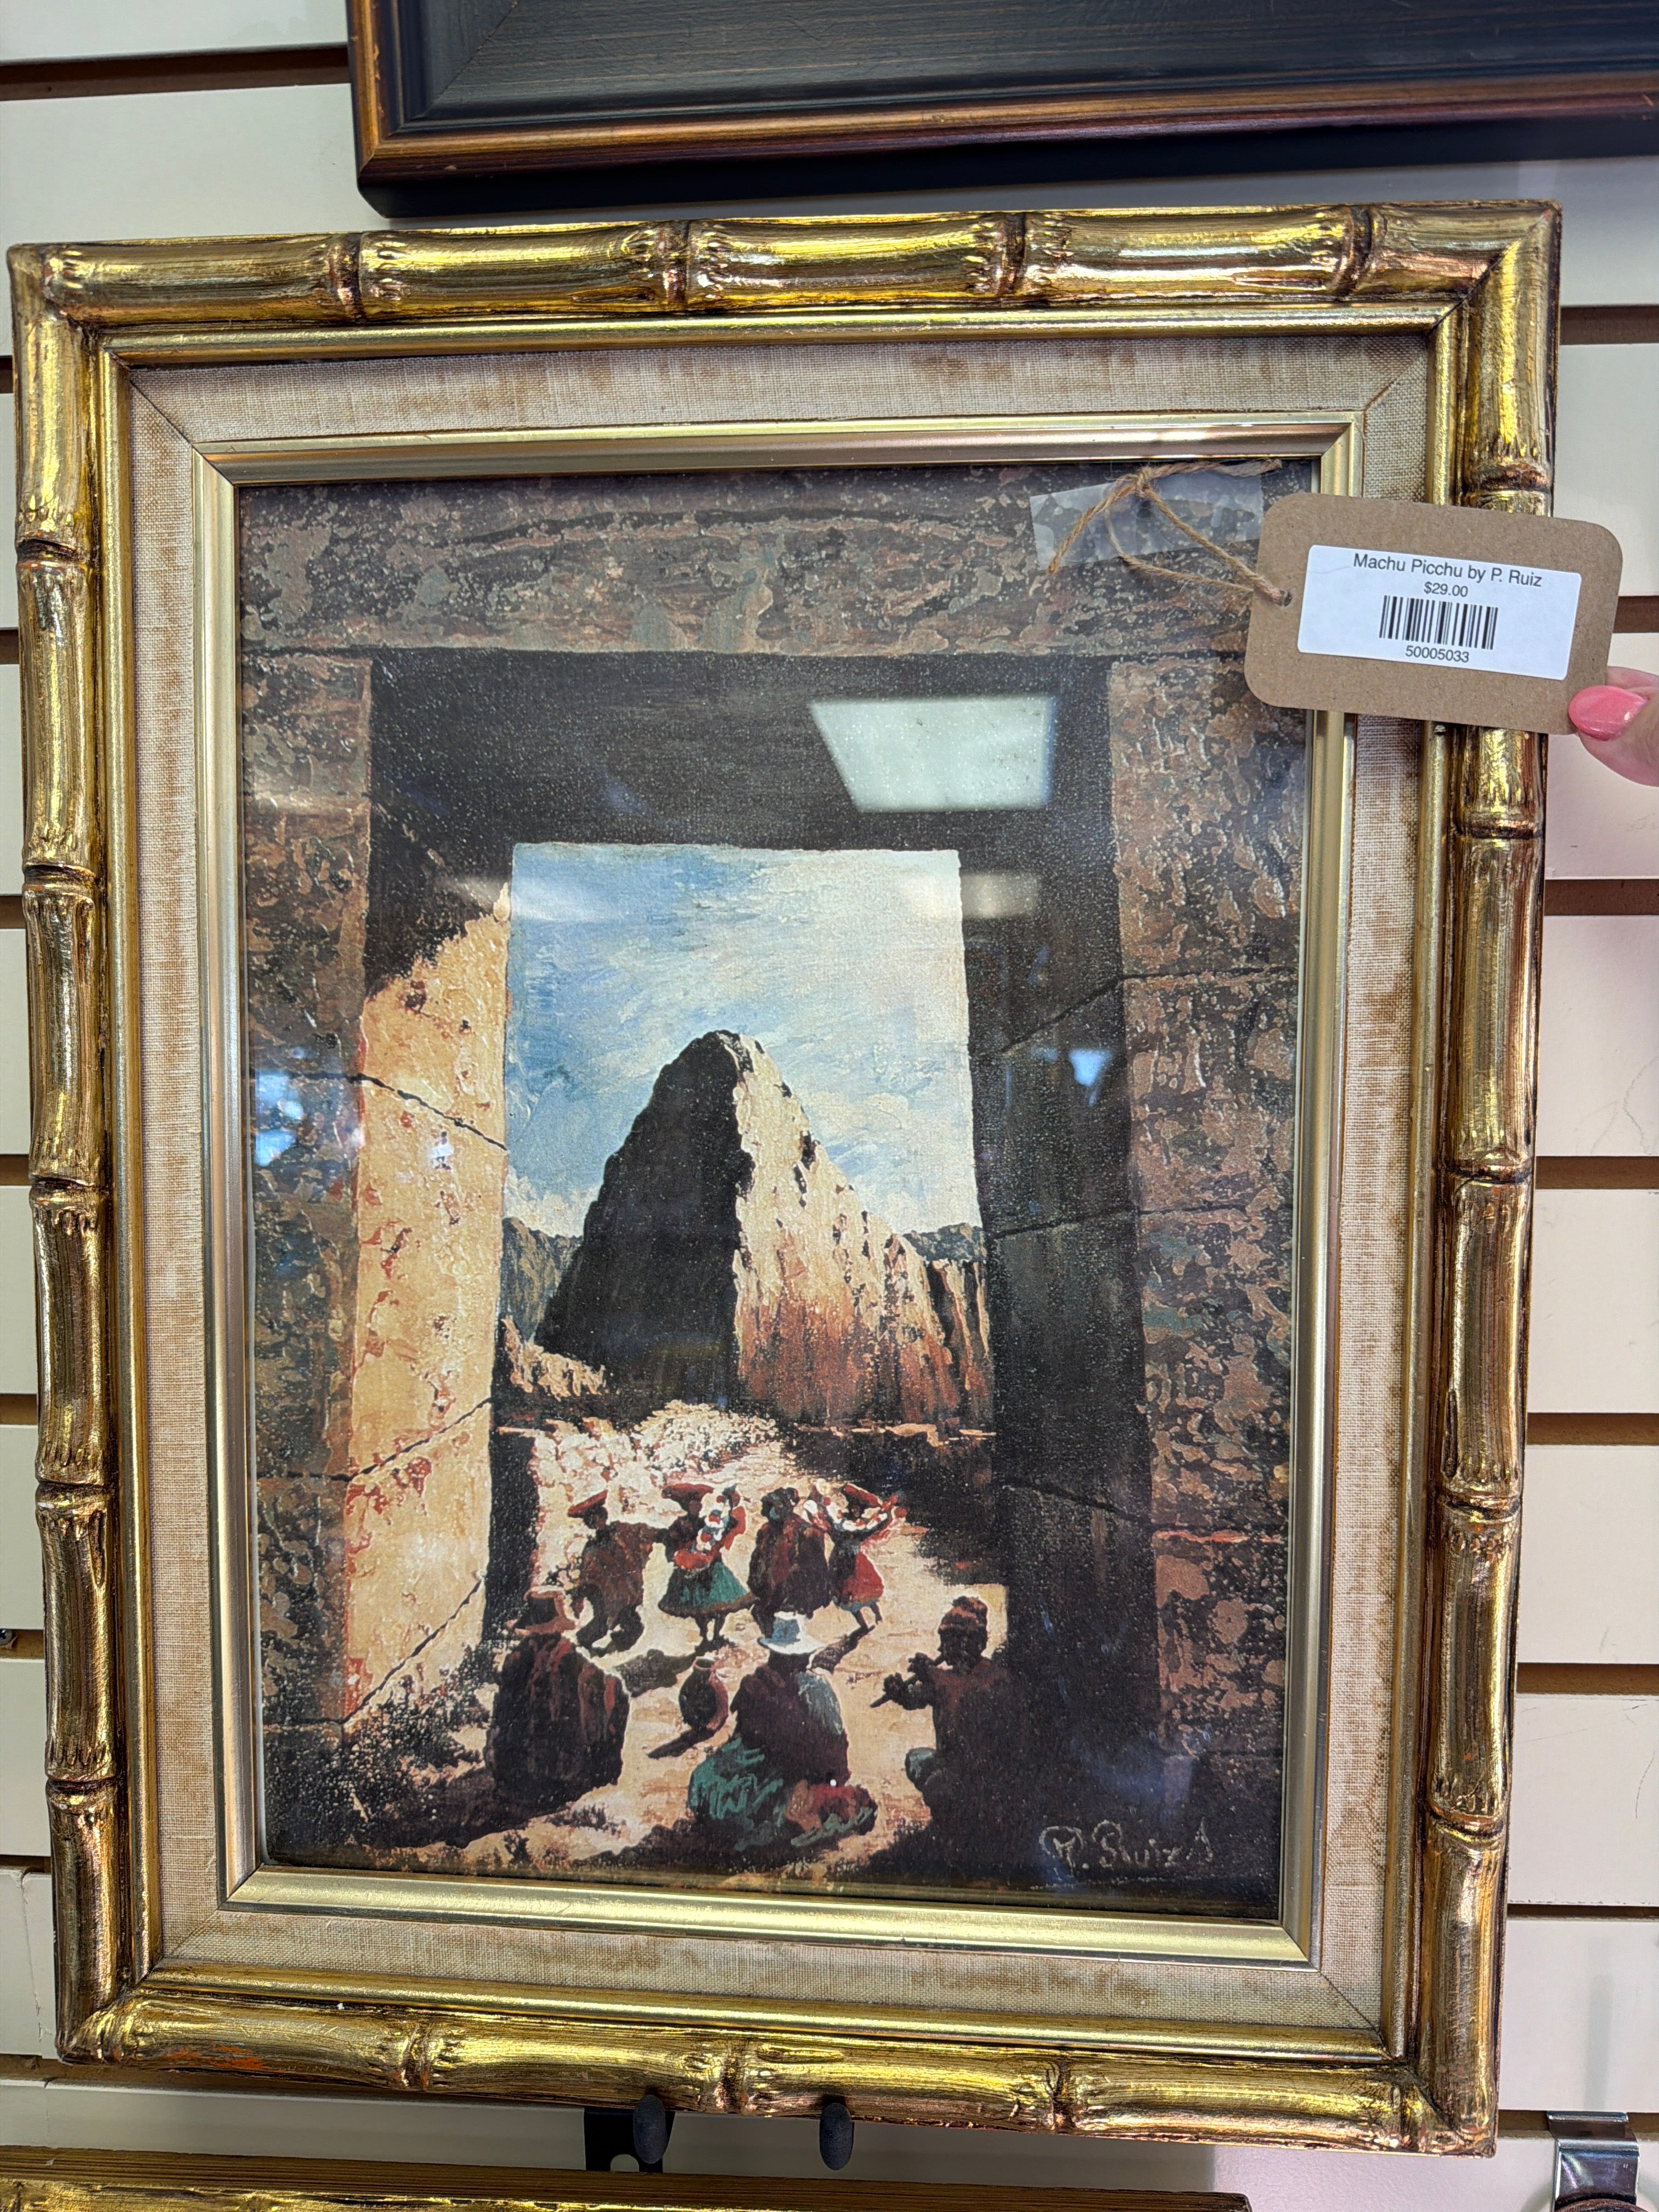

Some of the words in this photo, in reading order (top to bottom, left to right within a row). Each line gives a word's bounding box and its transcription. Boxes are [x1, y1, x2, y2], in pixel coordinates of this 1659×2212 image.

[1353, 553, 1405, 572] Machu
[1411, 558, 1463, 578] Picchu
[1468, 564, 1486, 583] by
[1491, 567, 1503, 583] P.
[1509, 571, 1542, 587] Ruiz
[1424, 581, 1468, 598] $29.00
[1405, 645, 1470, 663] 50005033
